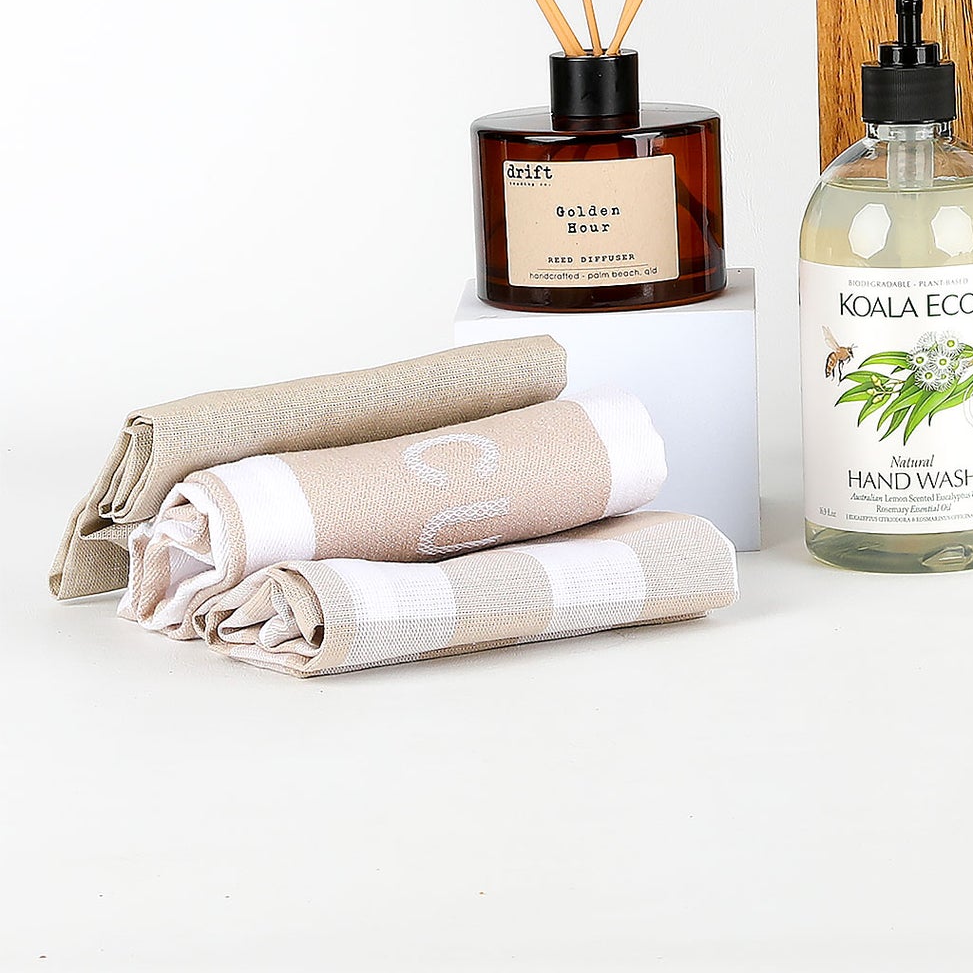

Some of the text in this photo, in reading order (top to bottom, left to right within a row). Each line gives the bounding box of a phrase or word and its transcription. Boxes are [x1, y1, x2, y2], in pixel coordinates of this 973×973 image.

[507, 164, 552, 179] drift
[556, 206, 621, 218] Golden
[568, 222, 610, 234] Hour
[580, 254, 636, 263] DIFFUSER
[588, 272, 610, 280] palm
[848, 280, 910, 288] BIODEGRADABLE
[840, 292, 918, 318] KOALA
[890, 454, 935, 468] Natural
[848, 470, 911, 490] HAND
[850, 492, 884, 502] Australian
[885, 494, 908, 502] Lemon
[909, 493, 934, 502] Scented
[876, 504, 910, 515] Rosemary
[910, 504, 940, 513] Essential
